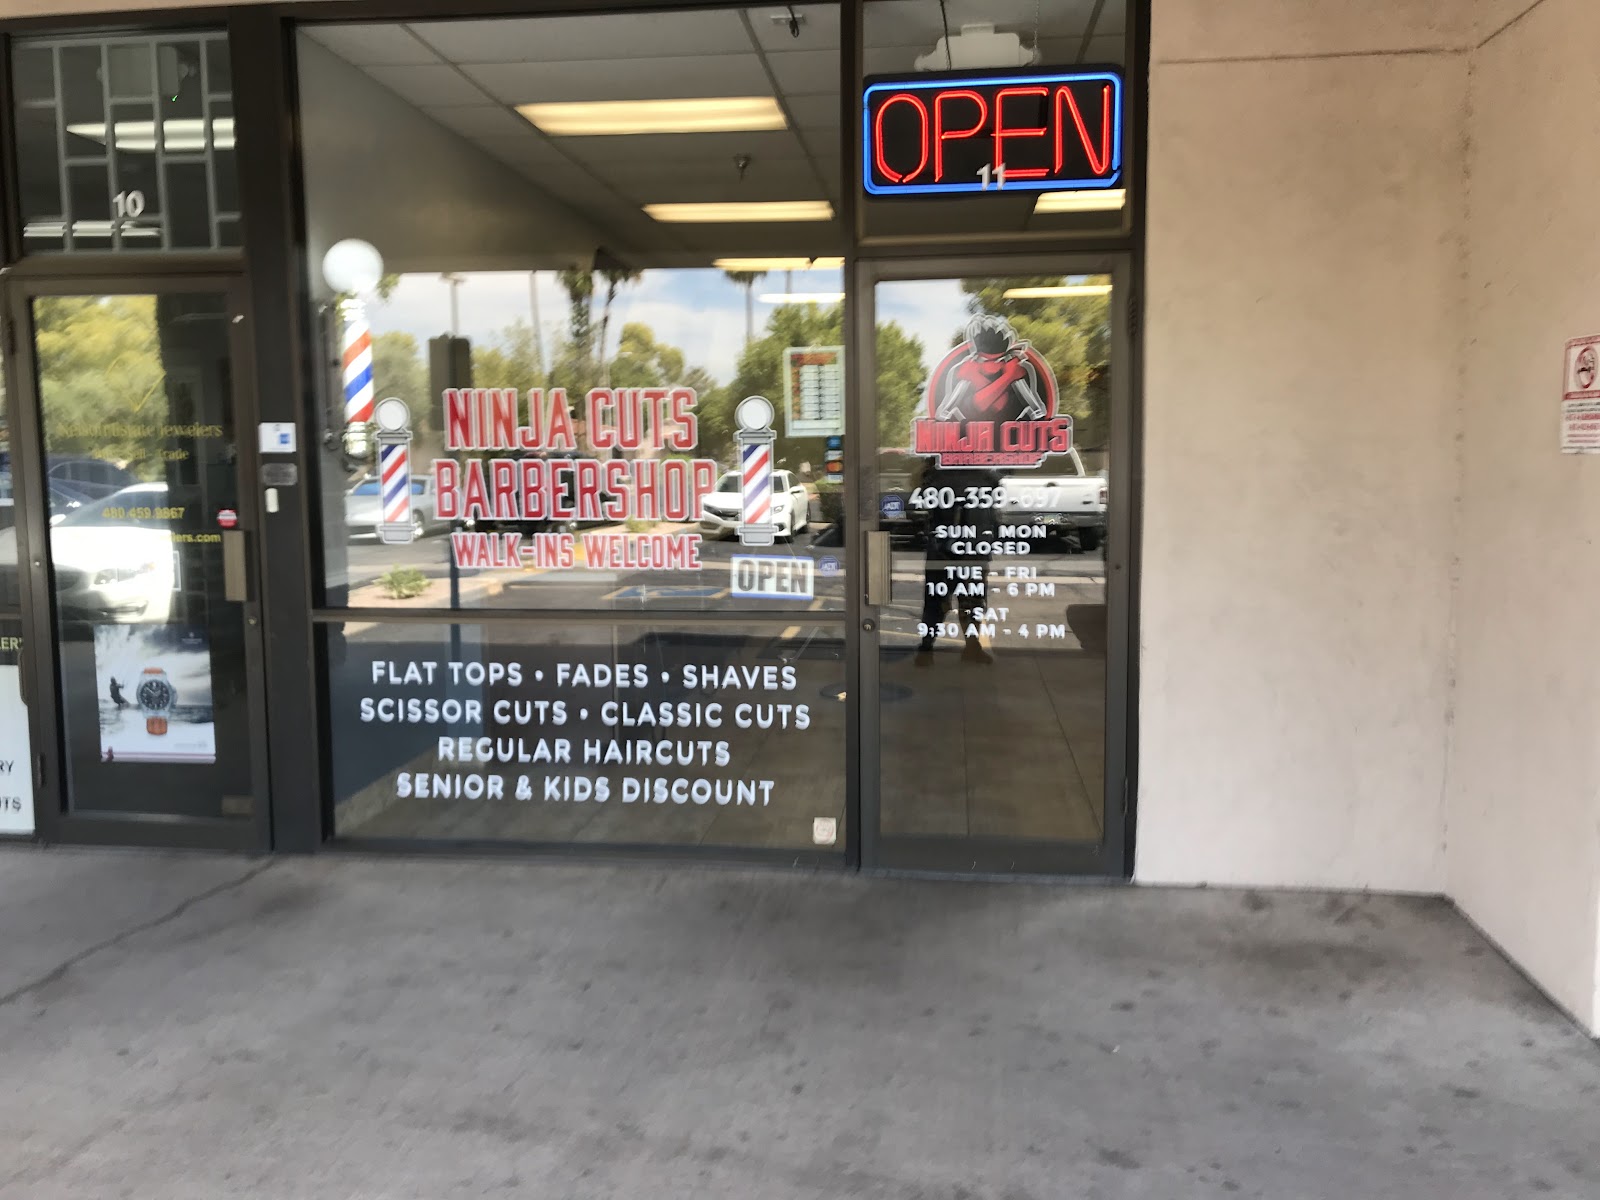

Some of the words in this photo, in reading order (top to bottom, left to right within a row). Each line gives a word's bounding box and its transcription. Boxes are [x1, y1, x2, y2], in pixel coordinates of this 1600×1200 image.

[875, 85, 1111, 183] OPEN
[976, 163, 1007, 191] 11
[112, 190, 145, 218] 10
[442, 387, 577, 450] NINJA
[585, 387, 699, 451] CUTS
[916, 420, 994, 452] NINJA
[1001, 419, 1069, 452] CUTS
[433, 458, 718, 522] BARBERSHOP
[935, 525, 977, 539] SUN
[998, 525, 1047, 539] MON
[451, 532, 575, 569] WALK-INS
[582, 533, 703, 570] WELCOME
[951, 541, 1031, 555] CLOSED
[738, 560, 809, 594] OPEN
[944, 566, 983, 580] TUE
[1004, 566, 1037, 580] FRI
[926, 582, 948, 597] 10
[953, 583, 985, 597] AM
[1007, 583, 1019, 597] 6
[1025, 583, 1055, 597] PM
[972, 607, 1010, 622] SAT
[917, 623, 959, 638] 9:30
[965, 624, 996, 638] AM
[1018, 624, 1029, 638] 4
[1036, 624, 1066, 639] PM
[372, 661, 437, 685] FLAT
[448, 661, 522, 687] TOPS
[556, 663, 649, 688] FADES
[682, 665, 798, 691] SHAVES
[359, 698, 482, 724] SCISSOR
[493, 700, 567, 726] CUTS
[601, 702, 723, 729] CLASSIC
[735, 704, 811, 731] CUTS
[438, 736, 571, 764] REGULAR
[583, 738, 731, 767] HAIRCUTS
[397, 772, 504, 800] SENIOR
[515, 775, 532, 800] &
[544, 776, 610, 802] KIDS
[621, 778, 775, 807] DISCOUNT
